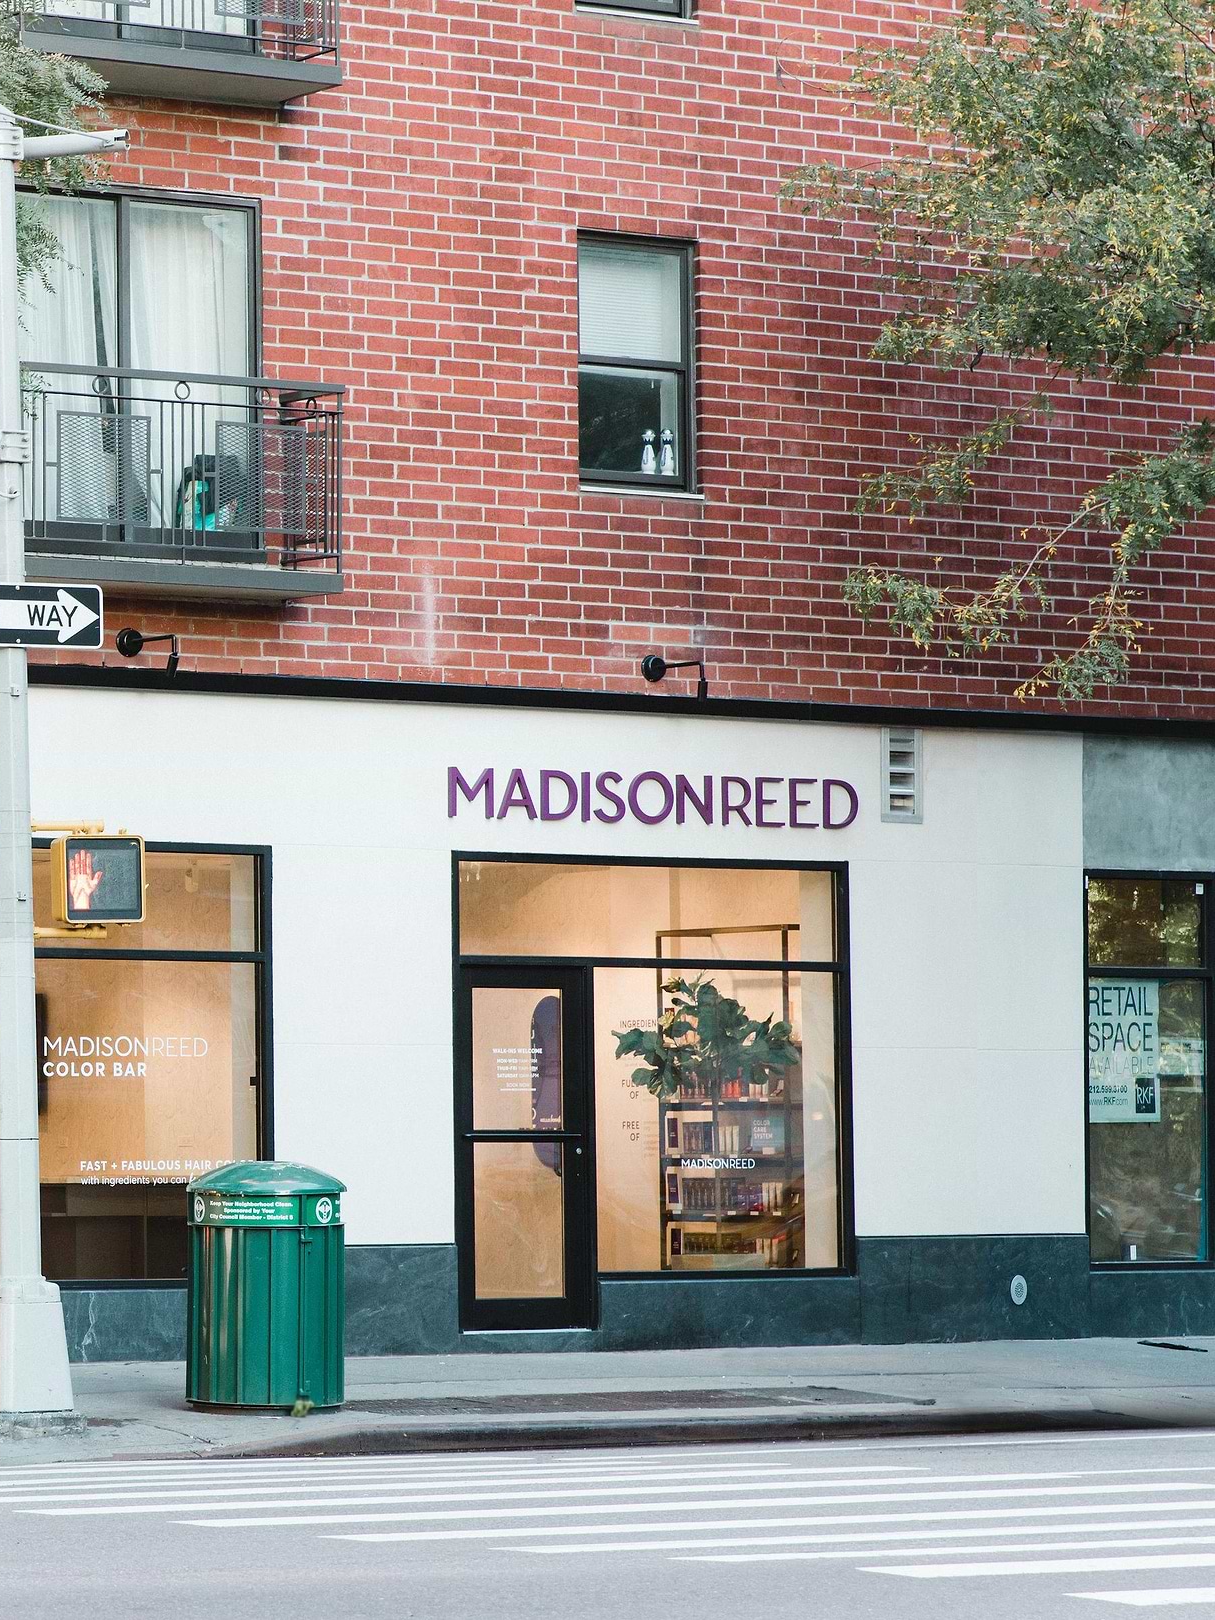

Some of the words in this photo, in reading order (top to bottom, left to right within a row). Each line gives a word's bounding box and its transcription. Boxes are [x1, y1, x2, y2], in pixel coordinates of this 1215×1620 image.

[27, 603, 79, 628] WAY
[447, 766, 859, 830] MADISONREED
[1088, 986, 1153, 1016] RETAIL
[1088, 1022, 1153, 1052] SPACE
[42, 1036, 208, 1057] MADISONREED
[42, 1061, 106, 1078] COLOR
[113, 1062, 147, 1077] BAR
[621, 1079, 639, 1088] FUL
[629, 1091, 640, 1100] OF
[1136, 1086, 1154, 1104] RKF
[622, 1121, 640, 1130] FREE
[629, 1133, 640, 1142] OF
[753, 1132, 773, 1140] SYSTEM
[80, 1160, 107, 1171] FAST
[121, 1160, 181, 1171] FABULOUS
[185, 1159, 212, 1171] HAIR
[681, 1158, 756, 1170] MADISONREED
[80, 1175, 101, 1185] with
[101, 1175, 150, 1187] ingredients
[152, 1177, 169, 1187] you
[170, 1176, 187, 1185] can
